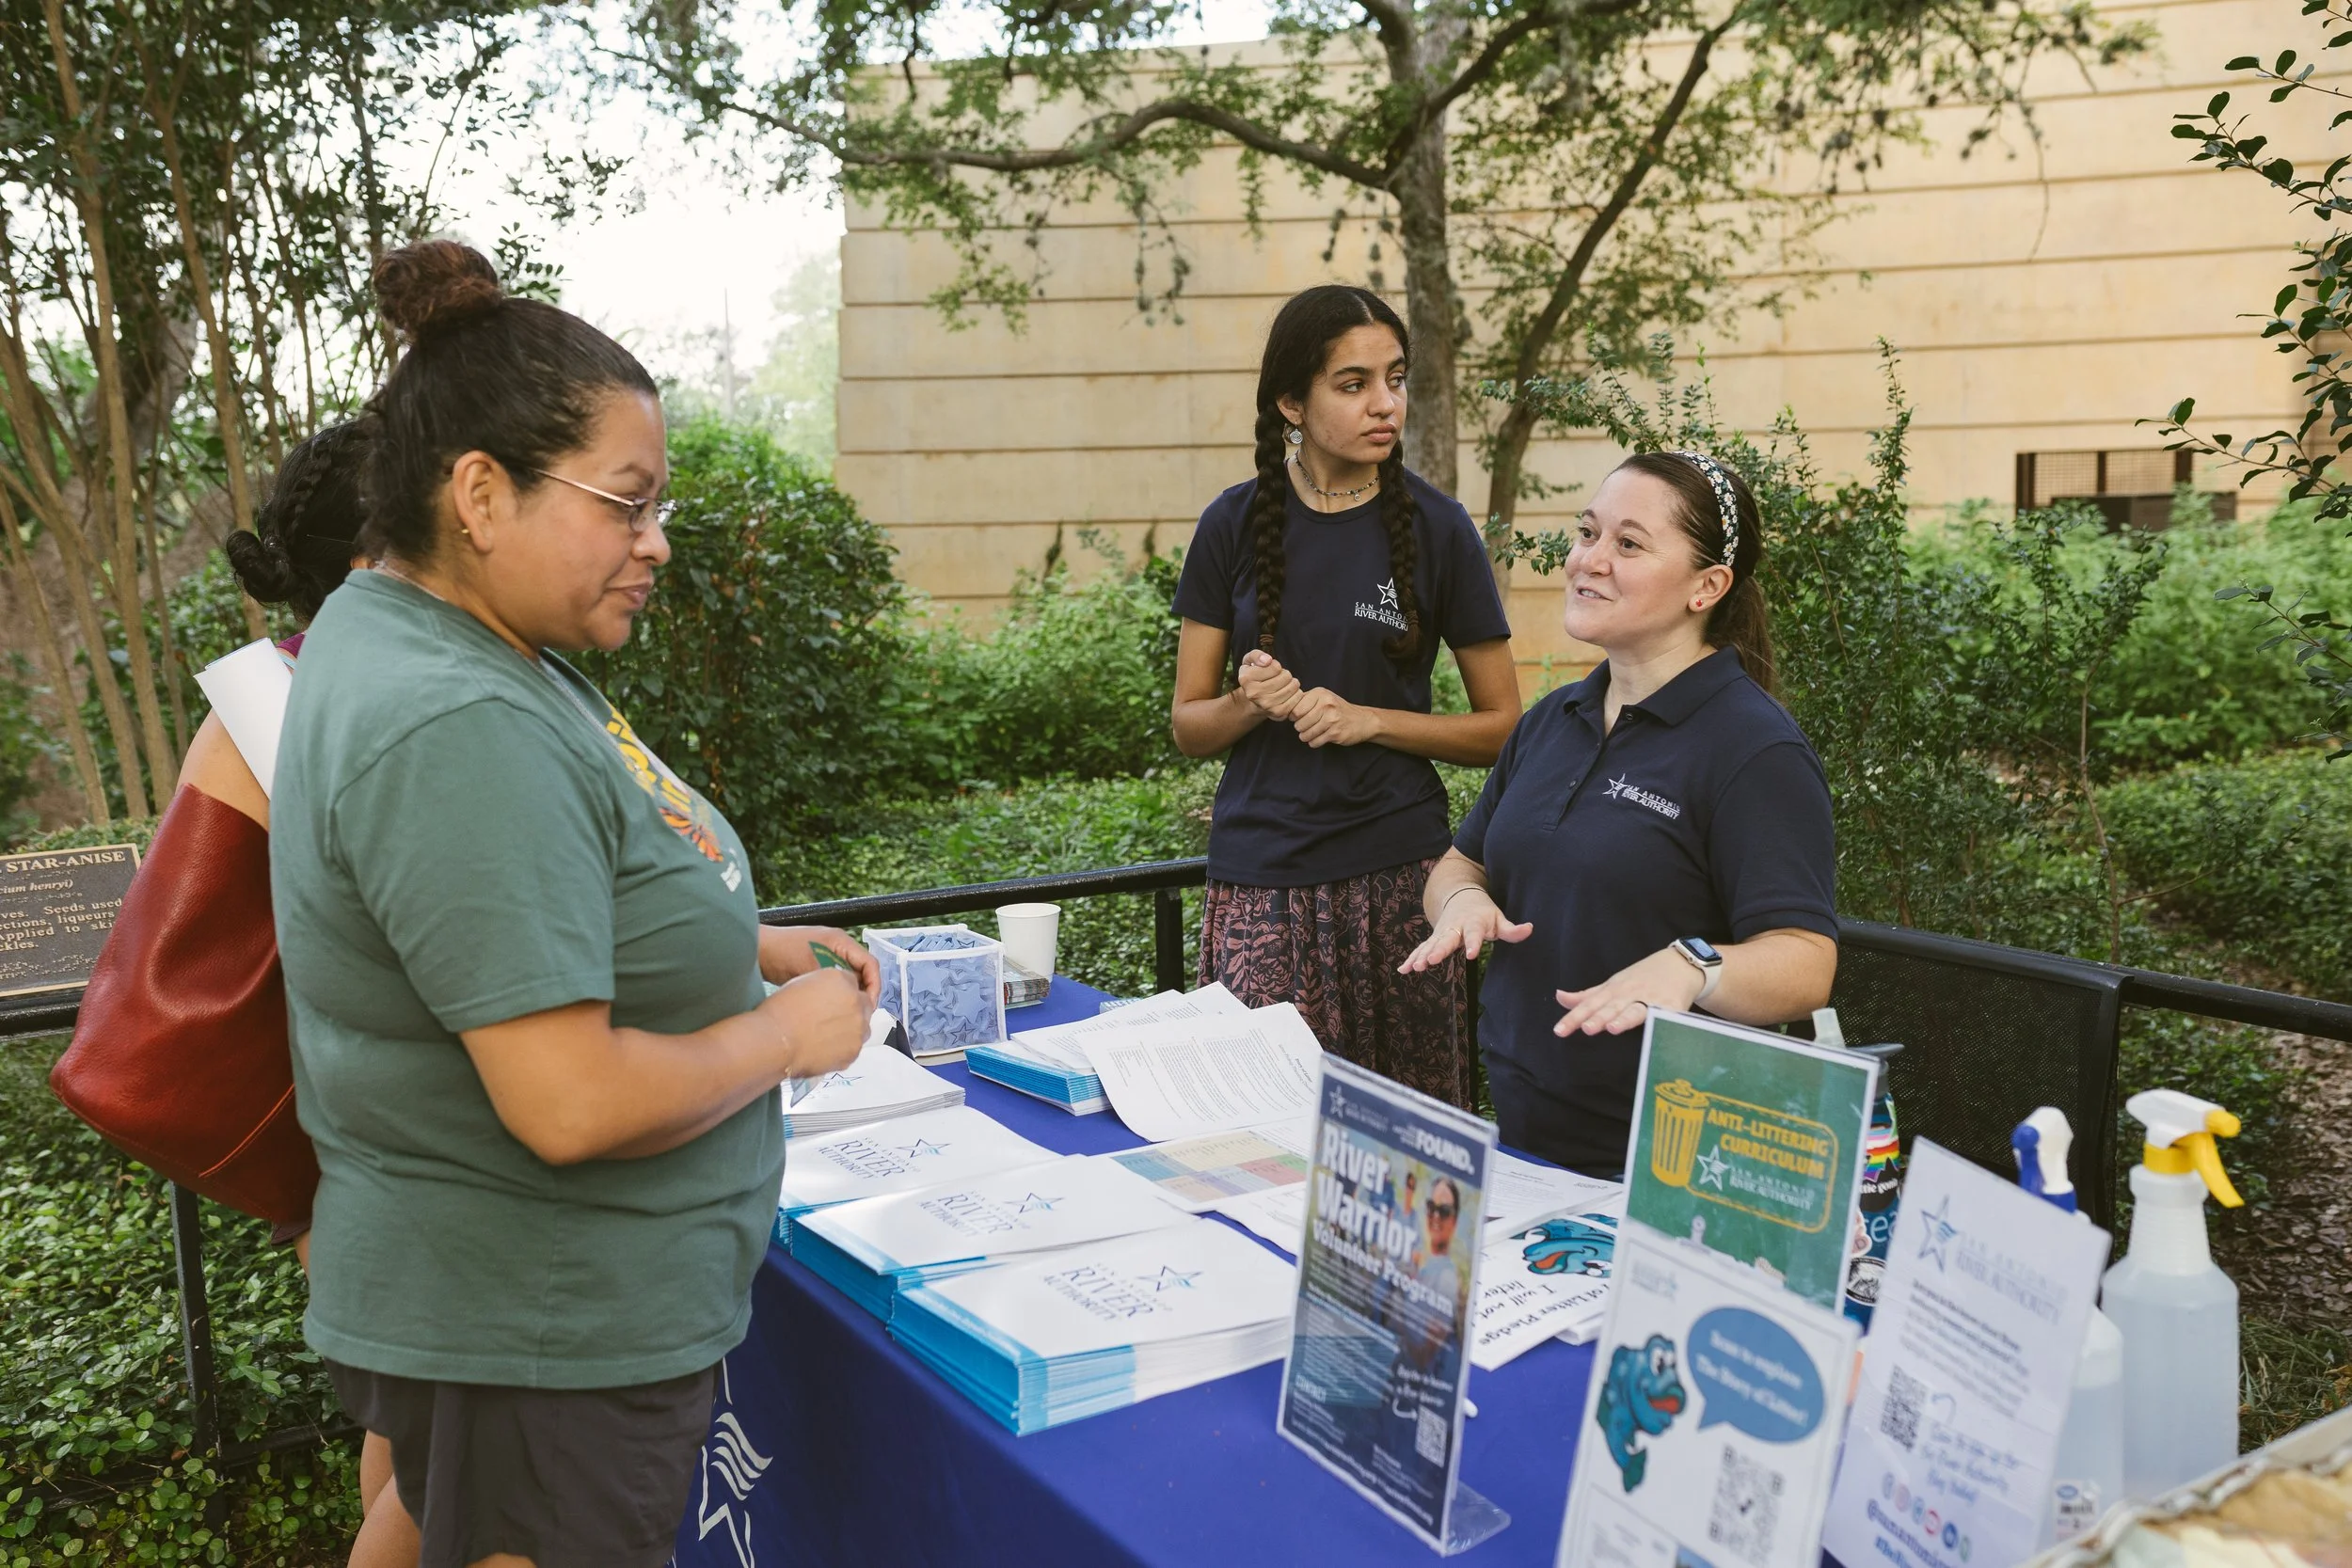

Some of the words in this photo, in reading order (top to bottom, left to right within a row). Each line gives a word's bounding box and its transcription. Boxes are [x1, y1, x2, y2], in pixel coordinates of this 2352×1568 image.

[1355, 601, 1374, 610] SAN
[1355, 609, 1377, 621] RIVER
[1638, 798, 1679, 820] AUTHORITY
[6, 850, 126, 873] STAR-ANISE
[29, 879, 74, 893] henryi)
[43, 903, 86, 916] Seeds
[91, 898, 122, 910] used
[57, 911, 115, 926] liqueurs
[66, 925, 81, 933] to
[91, 921, 117, 930] ski
[1707, 1107, 1829, 1157] ANTI-LITTERING
[817, 1147, 875, 1179] AUTHORITY
[834, 1140, 905, 1177] RIVER
[1321, 1123, 1391, 1196] River
[1720, 1132, 1825, 1180] CURRICULUM
[1729, 1176, 1756, 1193] RIVER
[1756, 1182, 1813, 1211] AUTHORITY
[1757, 1171, 1816, 1198] ANTONIO
[938, 1194, 1012, 1233] RIVER
[1313, 1171, 1418, 1264] Warrior
[1312, 1219, 1383, 1275] Volunteer
[1383, 1258, 1454, 1318] Program
[1061, 1266, 1153, 1317] RIVER
[1484, 1279, 1525, 1299] litter
[1509, 1290, 1537, 1307] will
[1478, 1302, 1506, 1320] not
[1479, 1314, 1540, 1346] Pledge
